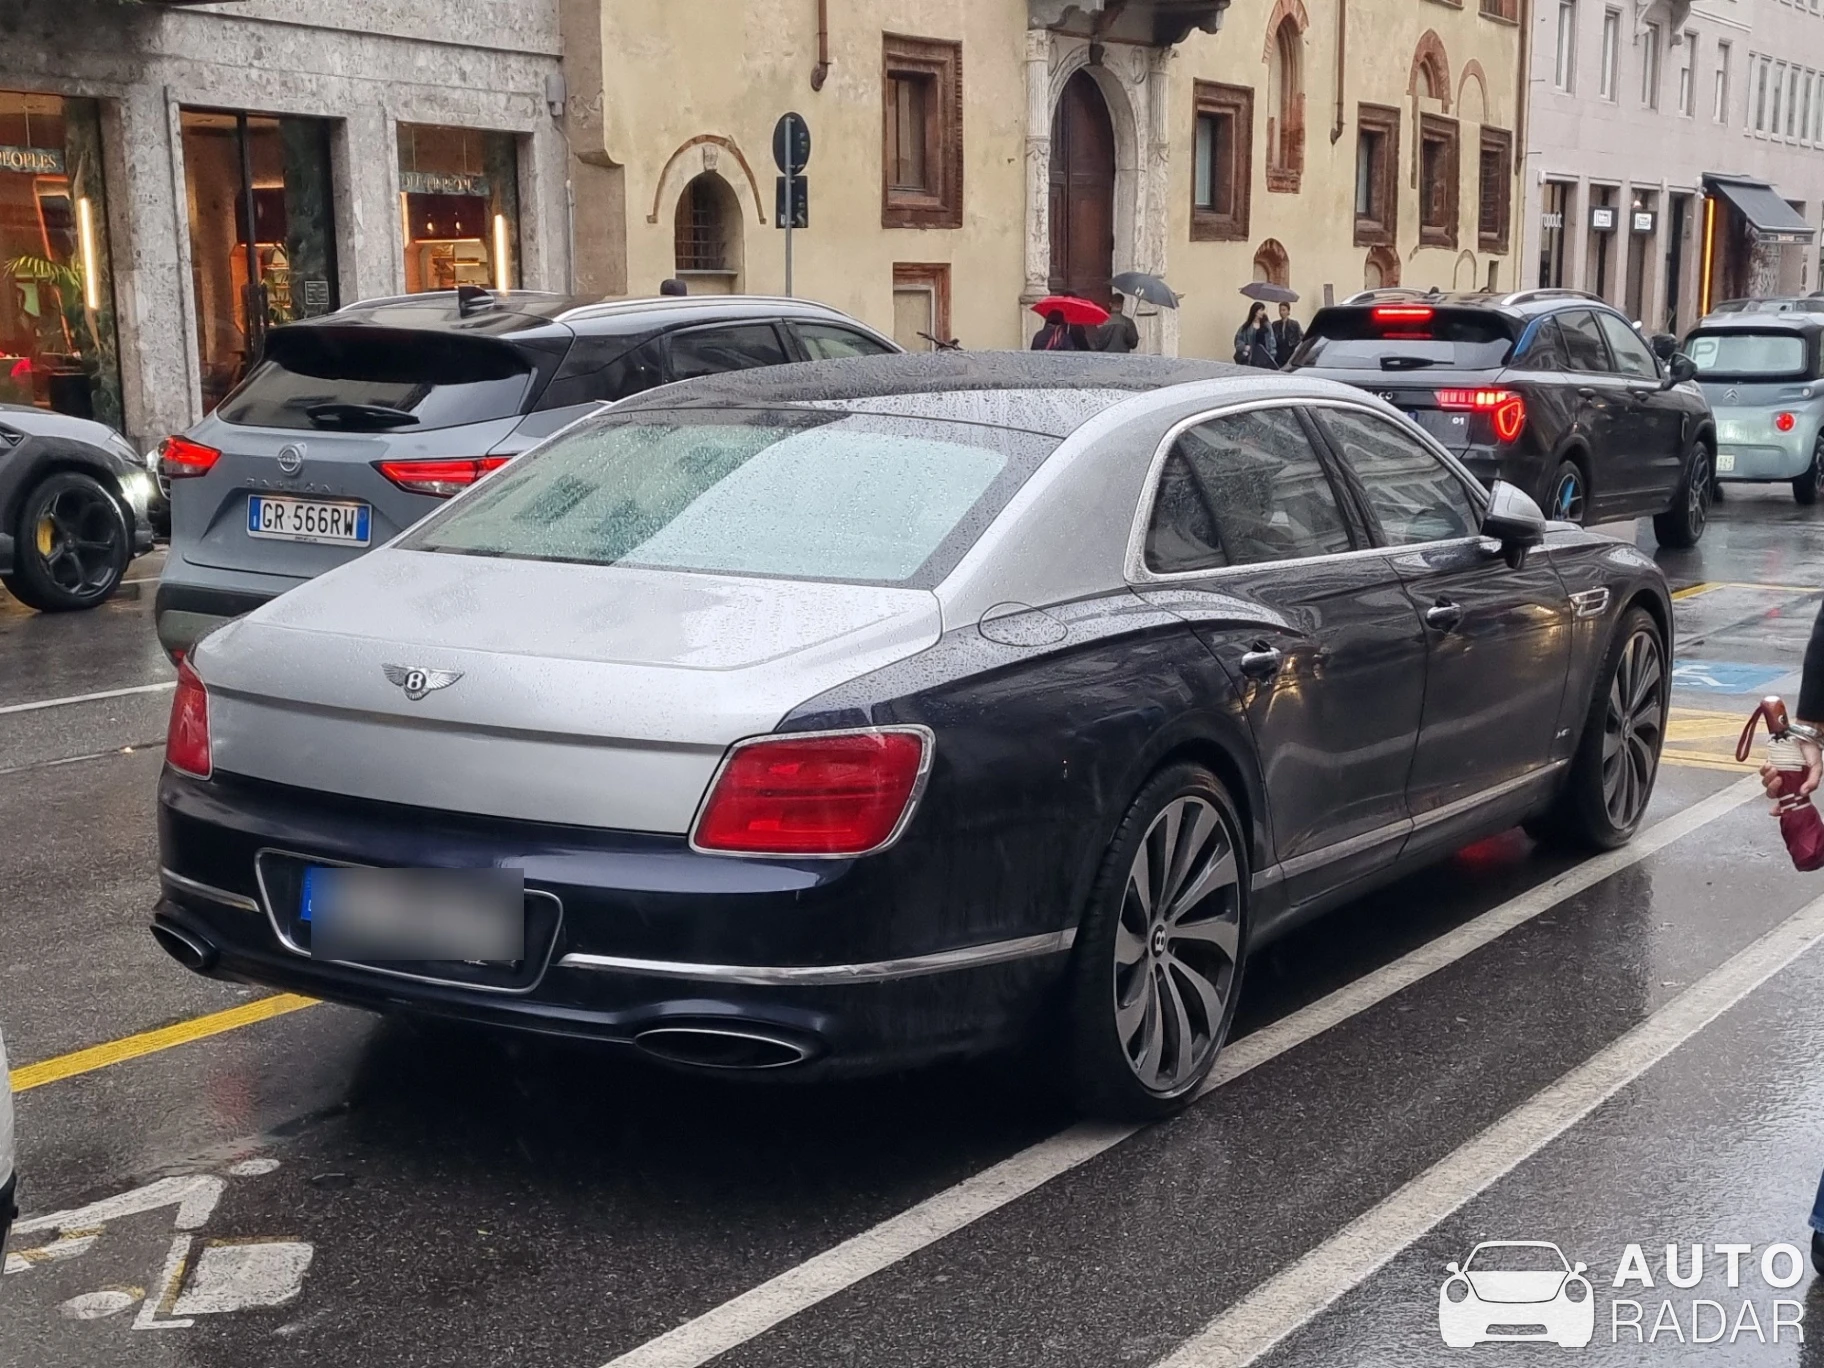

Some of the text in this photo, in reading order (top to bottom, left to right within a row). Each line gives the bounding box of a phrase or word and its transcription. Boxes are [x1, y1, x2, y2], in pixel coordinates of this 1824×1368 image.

[0, 151, 57, 168] EOPLES
[1452, 417, 1465, 425] 01
[262, 503, 355, 536] GR 566RW
[407, 672, 424, 690] B
